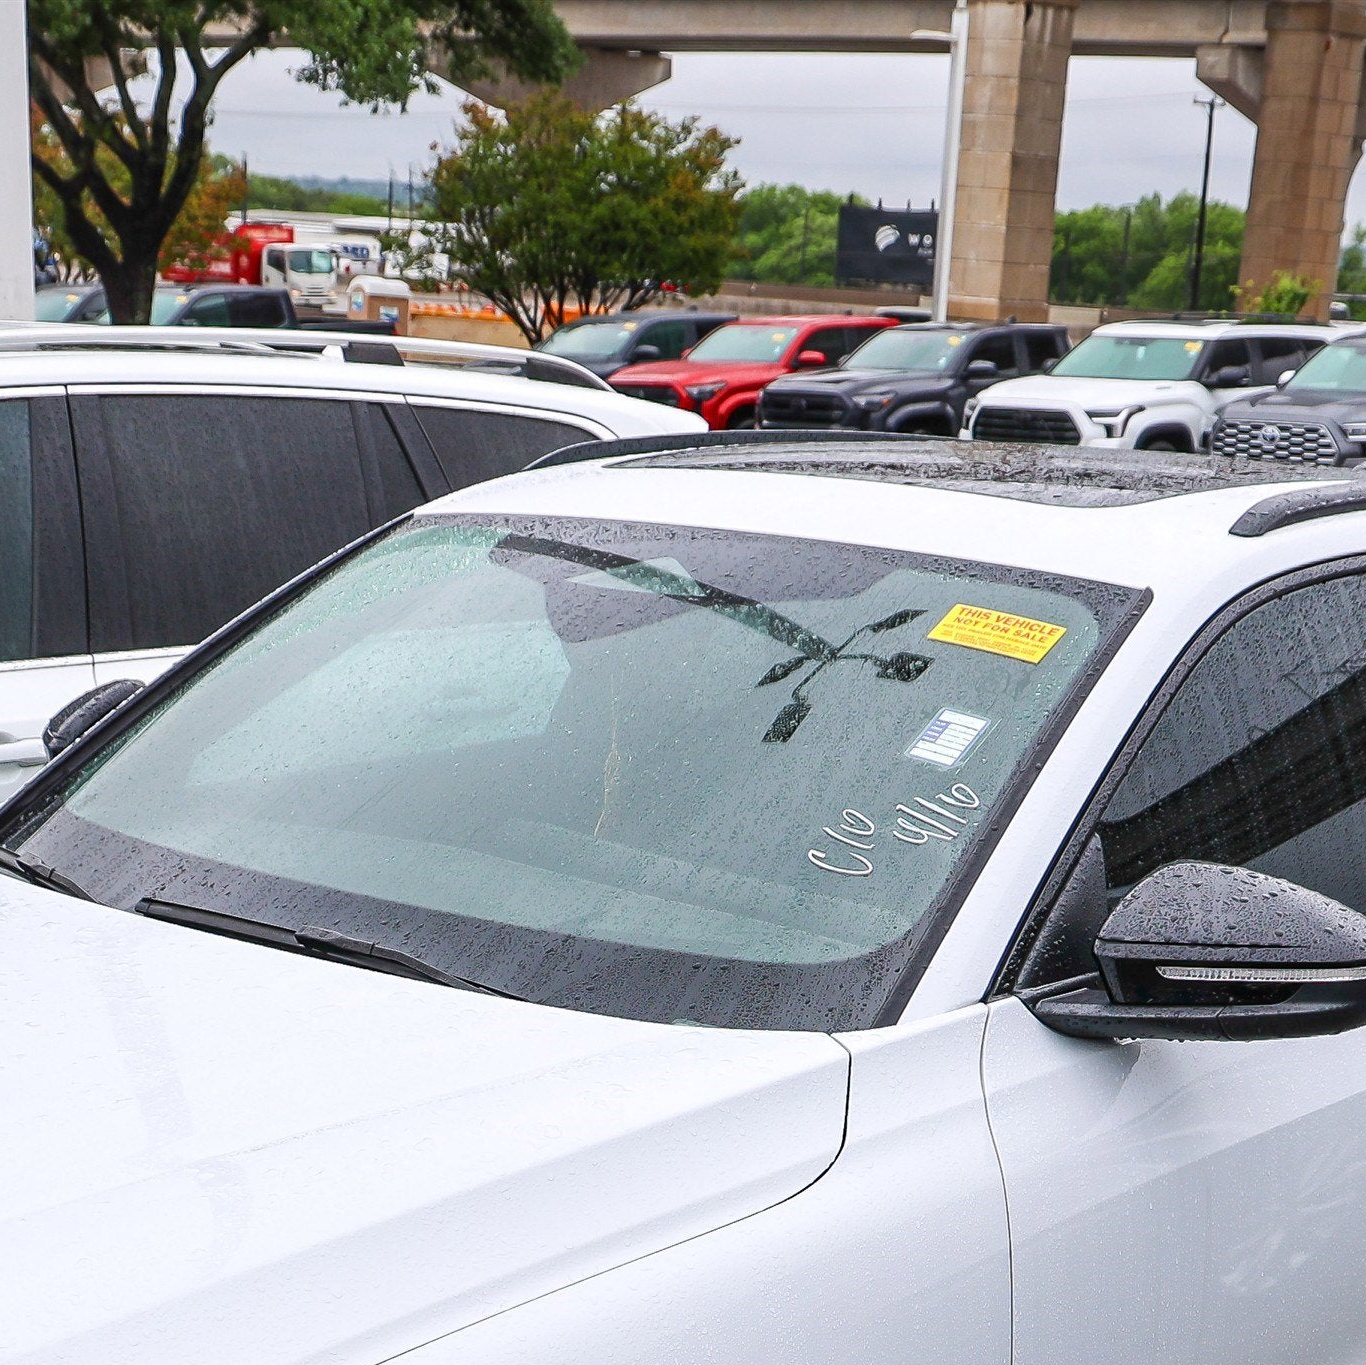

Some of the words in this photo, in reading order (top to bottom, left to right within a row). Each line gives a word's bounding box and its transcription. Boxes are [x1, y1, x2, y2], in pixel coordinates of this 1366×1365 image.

[954, 617, 980, 627] NOT
[982, 622, 1011, 634] FOR
[1013, 629, 1048, 643] SALE
[958, 607, 991, 620] THIS
[996, 614, 1060, 636] VEHICLE
